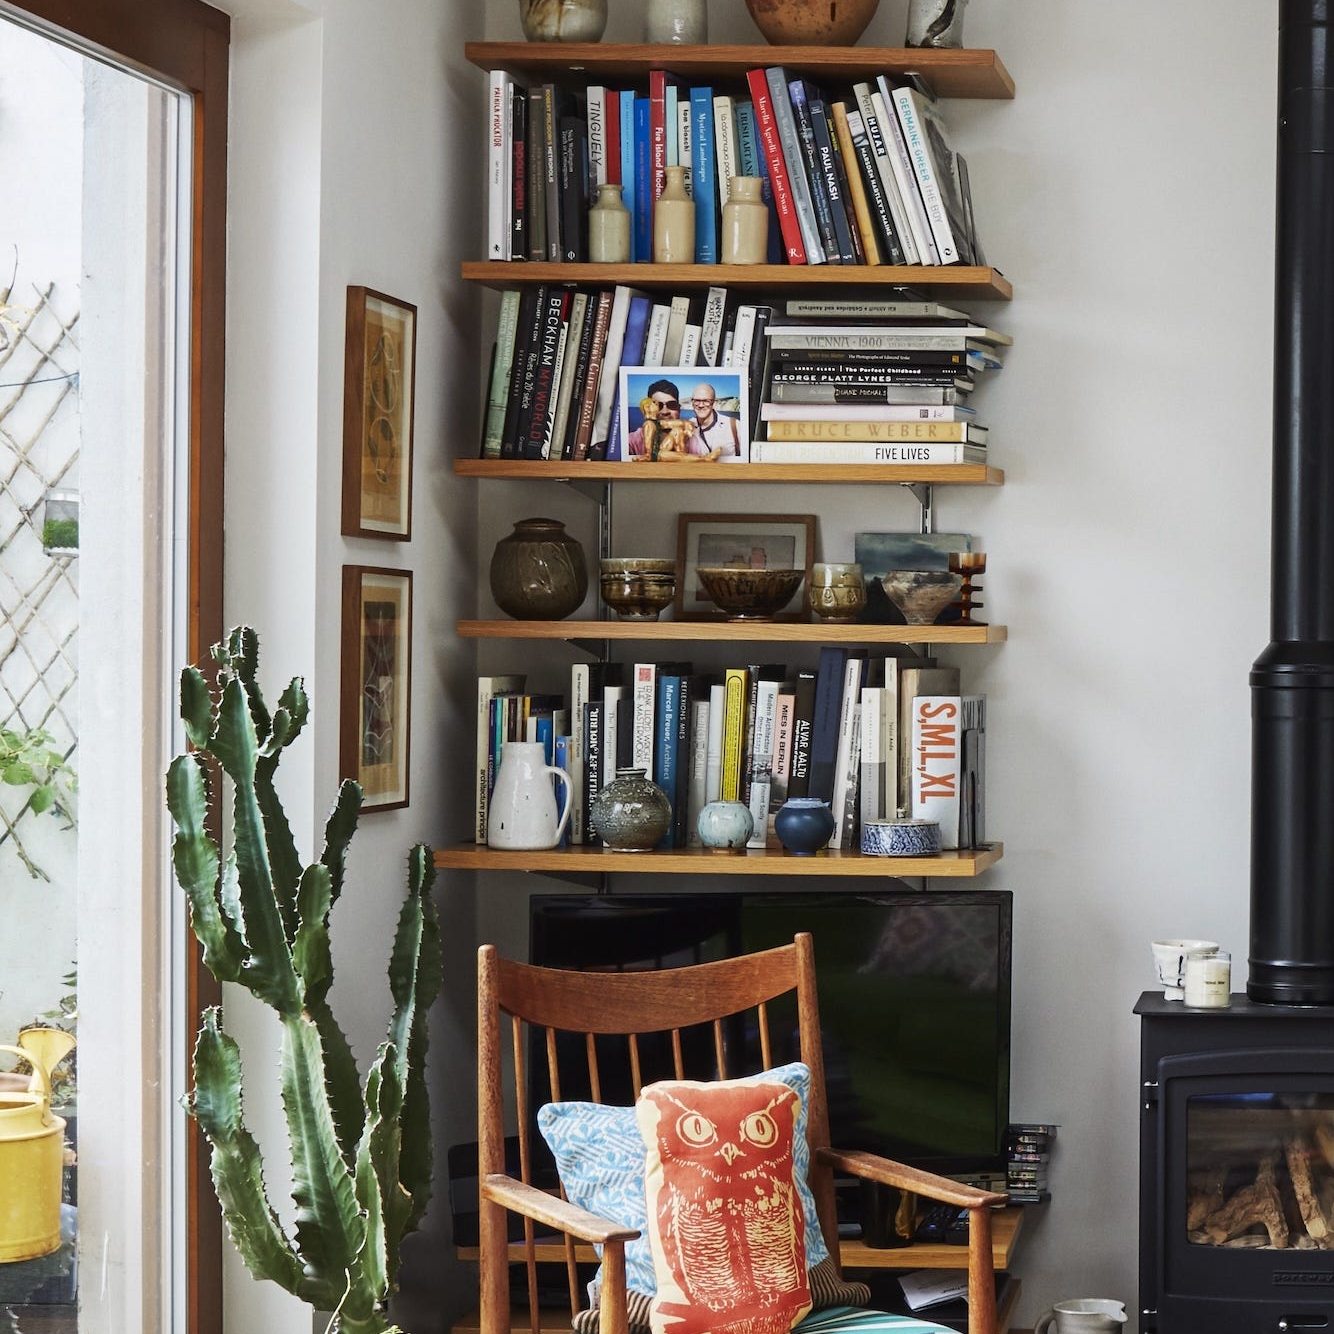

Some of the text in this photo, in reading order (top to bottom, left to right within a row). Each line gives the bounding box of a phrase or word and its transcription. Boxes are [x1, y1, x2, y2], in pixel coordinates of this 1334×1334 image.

[590, 101, 601, 166] TINGUELY
[740, 113, 752, 161] IRISH ART
[861, 95, 885, 155] Peter HUJAR
[758, 96, 788, 215] Marella Agnelli The Last Swan
[821, 147, 839, 201] PAUL NASH
[899, 97, 942, 223] GERMAINE GREER THE BOY
[860, 147, 892, 236] MARSDEN HARTLEY'S MAINE
[530, 298, 562, 440] BECKHAM MY WORLD
[685, 334, 693, 364] CLAUDE
[805, 336, 851, 348] VIENNA
[859, 337, 882, 348] 1900
[782, 424, 937, 437] BRUCE WEBER
[875, 448, 897, 460] FIVE
[901, 448, 930, 460] LIVES
[643, 735, 651, 764] WRIGHT
[663, 685, 673, 780] Marcel Breuer, Architect
[754, 716, 764, 753] Other Essays
[763, 693, 774, 754] Modern Architecture
[780, 729, 787, 739] IN
[797, 720, 810, 778] ALVAR AALTO
[777, 742, 786, 775] BERLIN
[917, 702, 957, 804] S,M,L,XL
[478, 769, 487, 838] architecture principe
